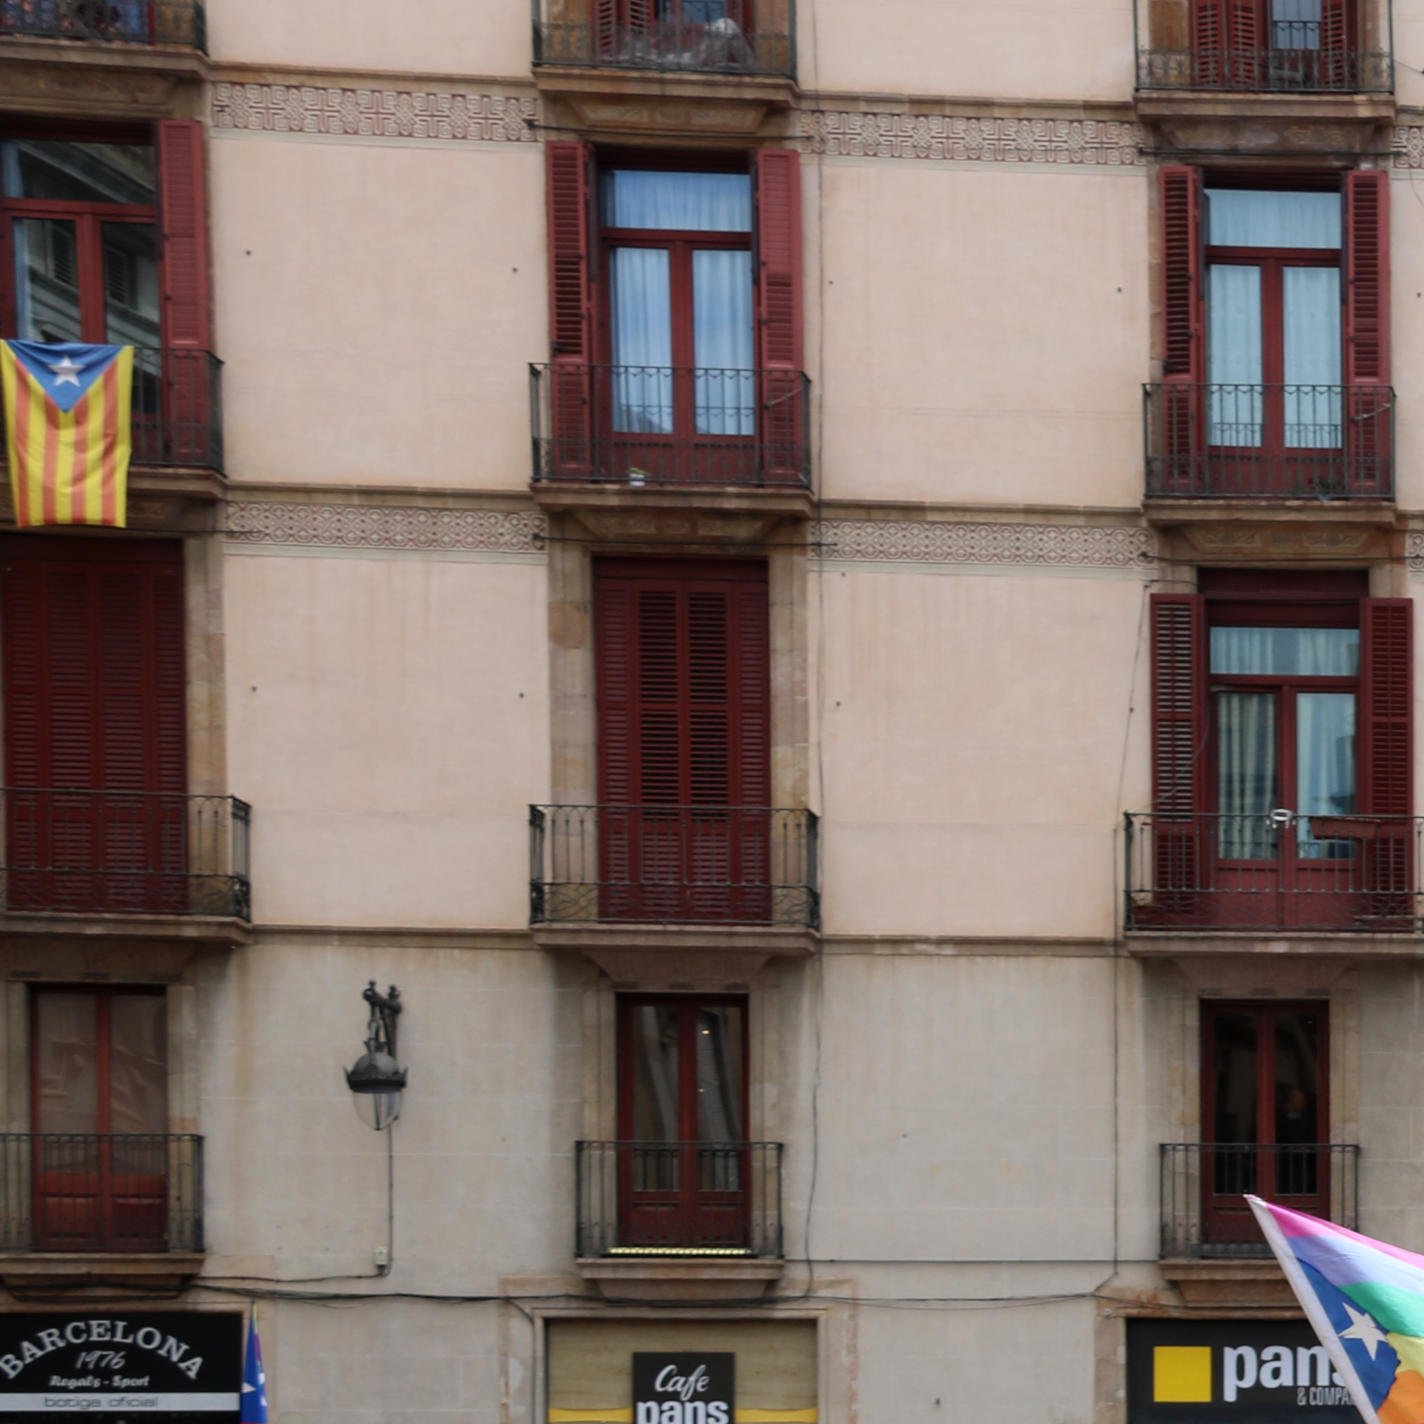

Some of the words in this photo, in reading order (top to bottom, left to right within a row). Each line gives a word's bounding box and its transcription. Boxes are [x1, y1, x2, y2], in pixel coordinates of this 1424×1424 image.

[0, 1320, 203, 1379] BARCELONA
[75, 1350, 126, 1370] 1976
[112, 1375, 150, 1388] Sport
[1309, 1387, 1354, 1405] COMPA
